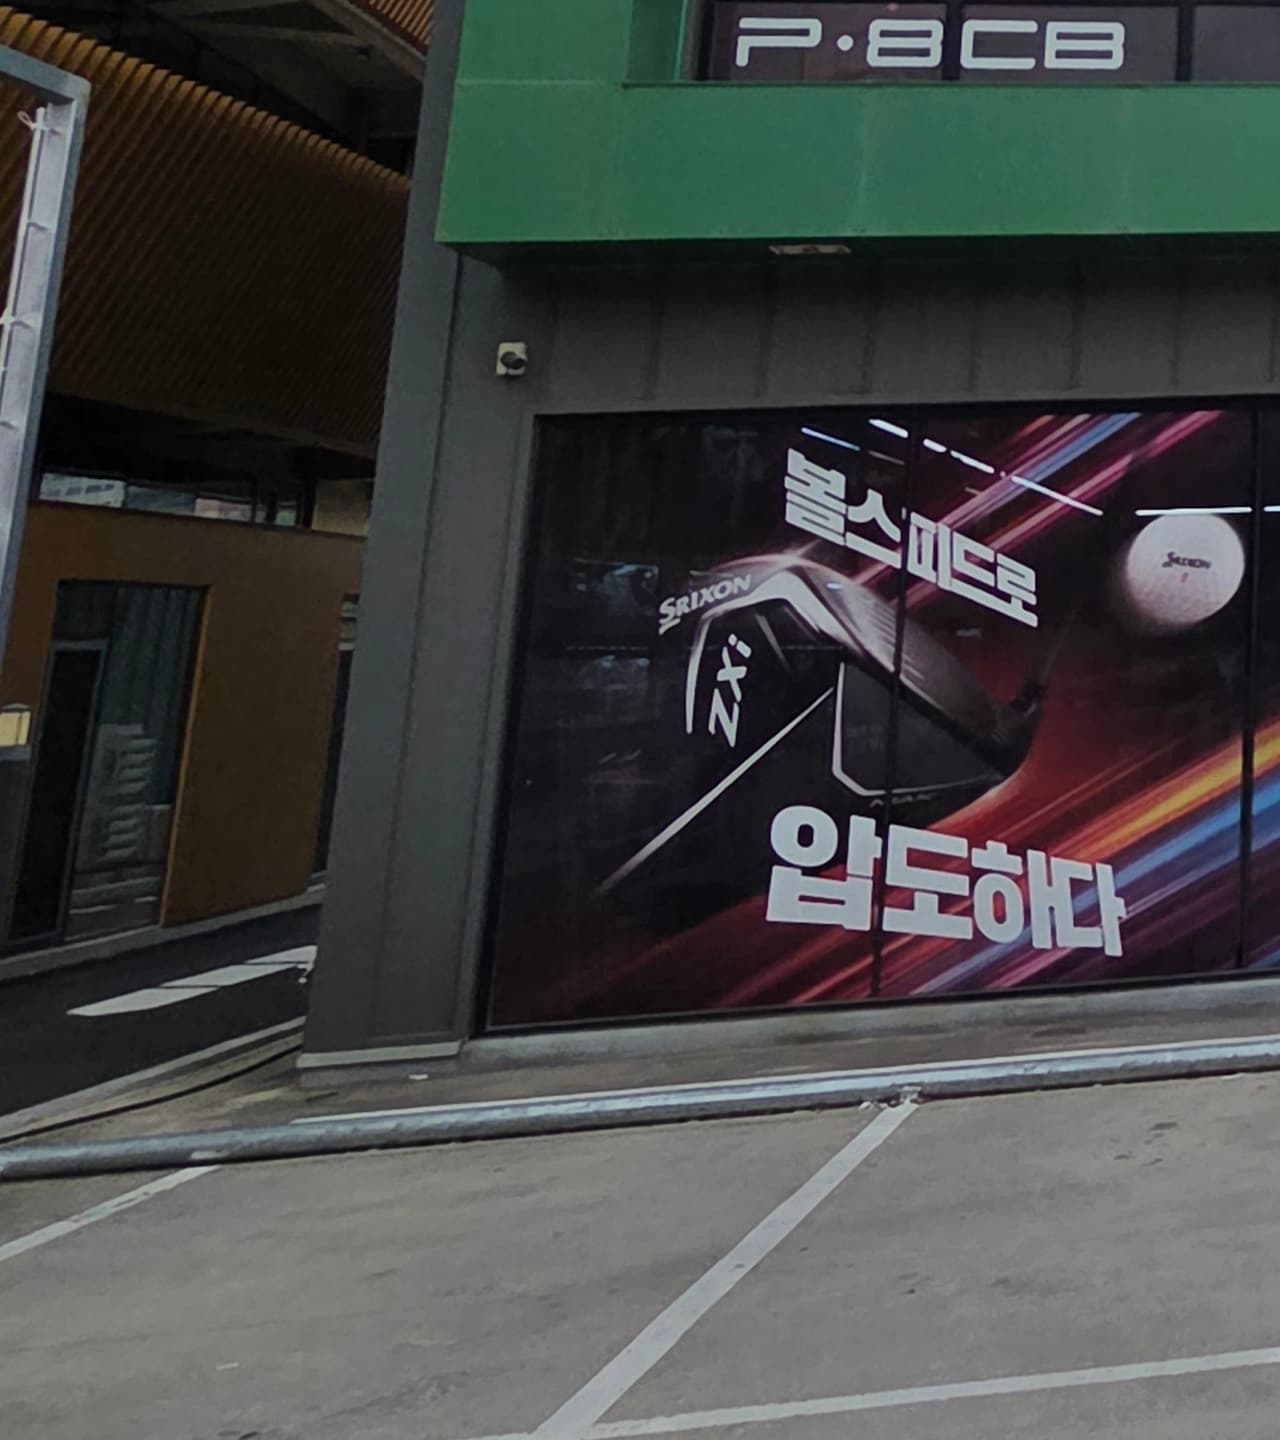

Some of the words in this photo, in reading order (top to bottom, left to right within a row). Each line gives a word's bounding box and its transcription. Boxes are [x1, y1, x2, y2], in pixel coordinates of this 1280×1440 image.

[658, 574, 753, 636] SRIXON
[784, 447, 1039, 628] 볼스피드로
[765, 804, 1127, 957] 압도하다
